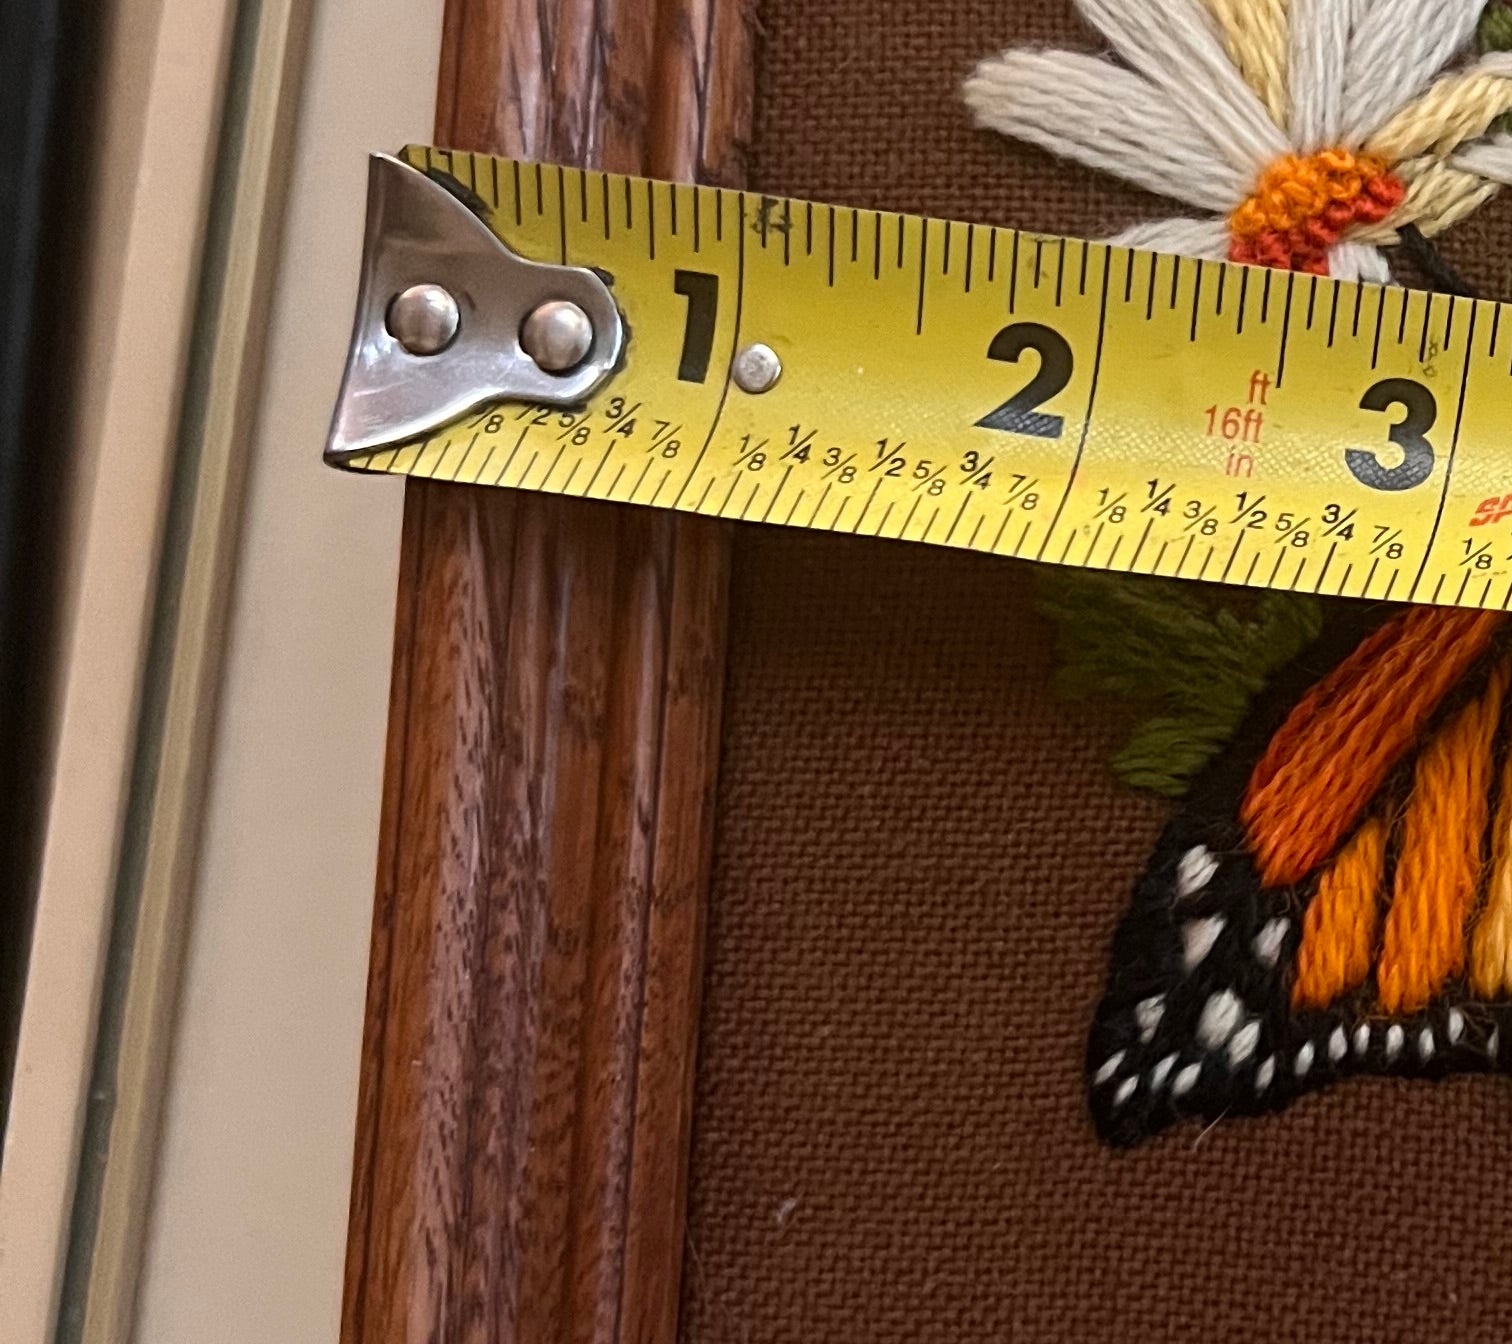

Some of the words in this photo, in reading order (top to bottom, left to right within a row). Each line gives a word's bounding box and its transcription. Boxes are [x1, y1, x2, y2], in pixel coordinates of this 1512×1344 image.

[674, 270, 719, 384] 1
[974, 322, 1074, 439] 2
[1204, 405, 1263, 444] 16ft
[1249, 370, 1274, 407] ft
[1345, 378, 1438, 491] 3
[605, 397, 644, 438] 3/4
[650, 420, 682, 458] 7/8
[739, 435, 767, 472] 1/8
[778, 425, 817, 465] 1/4
[823, 447, 858, 485] 3/8
[868, 438, 907, 478] 1/2
[912, 462, 948, 496] 5/8
[960, 450, 995, 489] 3/4
[1004, 474, 1039, 511] 7/8
[1094, 488, 1127, 524] 1/8
[1141, 479, 1174, 516] 1/4
[1183, 500, 1218, 536] 3/8
[1231, 492, 1268, 529] 1/2
[1275, 512, 1310, 548] 5/8
[1321, 504, 1358, 541] 3/4
[1369, 525, 1404, 560] 7/8
[1461, 538, 1493, 570] 1/8
[1226, 451, 1255, 479] in
